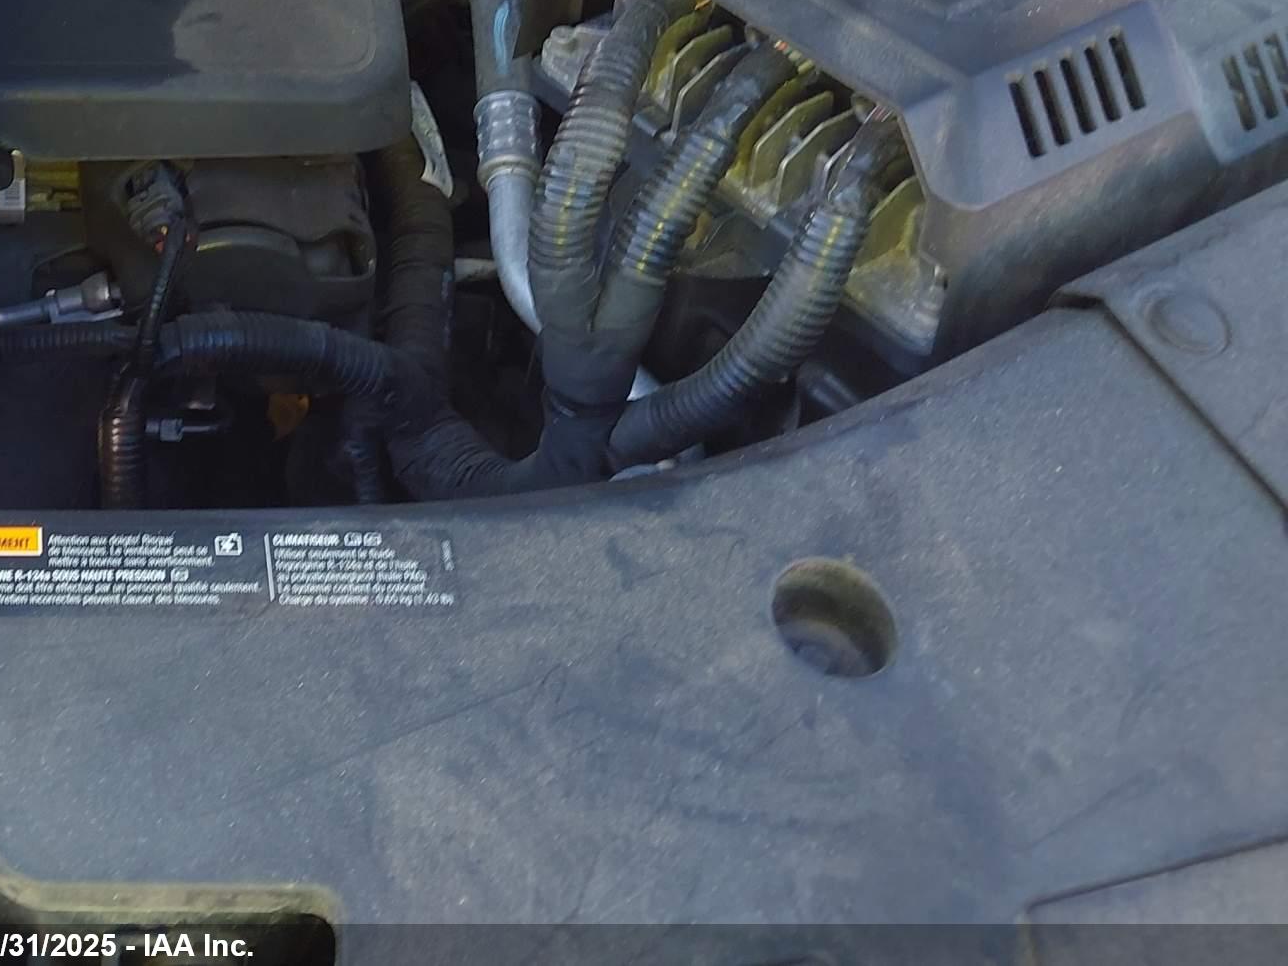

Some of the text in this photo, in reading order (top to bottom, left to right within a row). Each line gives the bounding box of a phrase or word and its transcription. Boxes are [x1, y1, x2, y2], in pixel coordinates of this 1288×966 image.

[48, 534, 89, 546] Attention
[52, 569, 80, 582] SOUS
[80, 569, 114, 582] HAUTE
[115, 569, 165, 582] PRESSION
